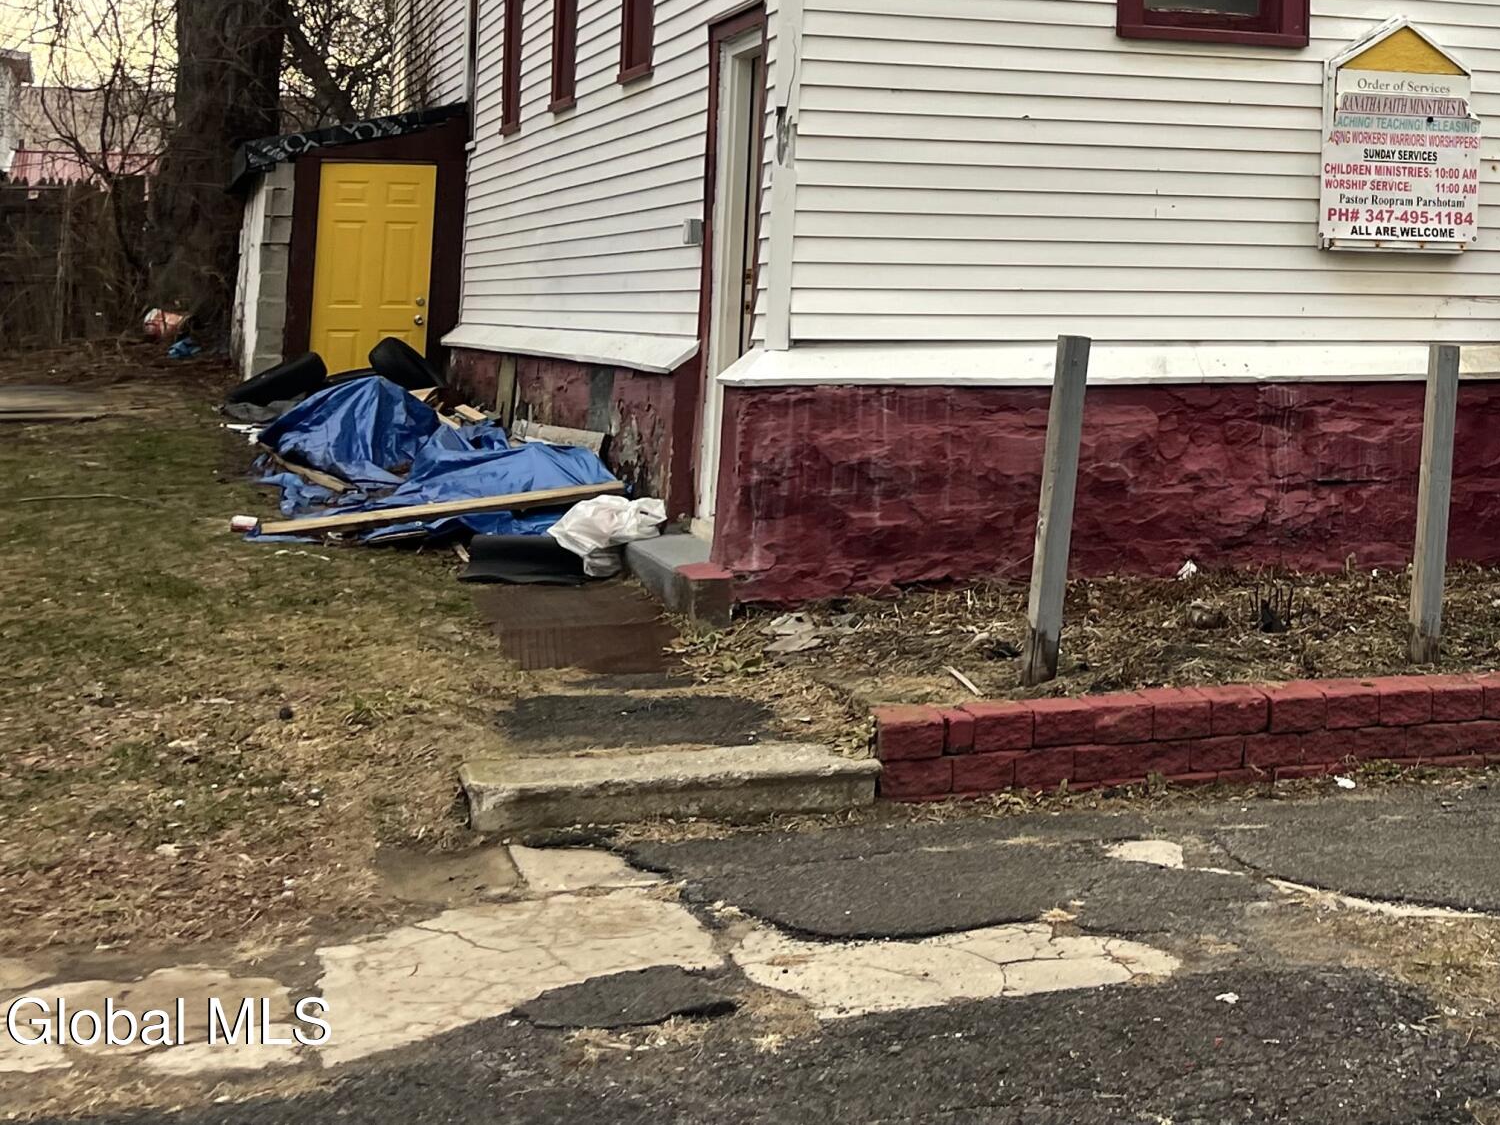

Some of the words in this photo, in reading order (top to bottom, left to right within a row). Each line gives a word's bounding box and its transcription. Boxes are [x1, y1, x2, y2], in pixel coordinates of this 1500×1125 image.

[1357, 78, 1390, 90] Order
[1393, 80, 1406, 91] of
[1407, 81, 1450, 93] Services
[1383, 97, 1408, 114] FAITH
[1409, 98, 1456, 116] MINISTRIES
[1376, 117, 1423, 131] TEACHING!
[1352, 131, 1388, 145] WORKERS!
[1363, 148, 1396, 160] SUNDAY
[1397, 150, 1438, 162] SERVICES
[1324, 163, 1372, 175] CHILDREN
[1374, 165, 1432, 178] MINISTRIES:
[1434, 167, 1460, 179] 10:00
[1462, 169, 1477, 180] AM
[1325, 179, 1367, 190] WORSHIP
[1369, 180, 1412, 192] SERVICE:
[1435, 183, 1460, 194] 11:00
[1462, 184, 1477, 194] AM
[1339, 193, 1369, 205] Pastor
[1371, 194, 1413, 208] Roopram
[1416, 196, 1465, 208] Parshotam
[1327, 207, 1360, 222] PH#
[1365, 209, 1474, 226] 347-495-1184
[1350, 226, 1372, 236] ALL
[1400, 227, 1455, 238] WELCOME
